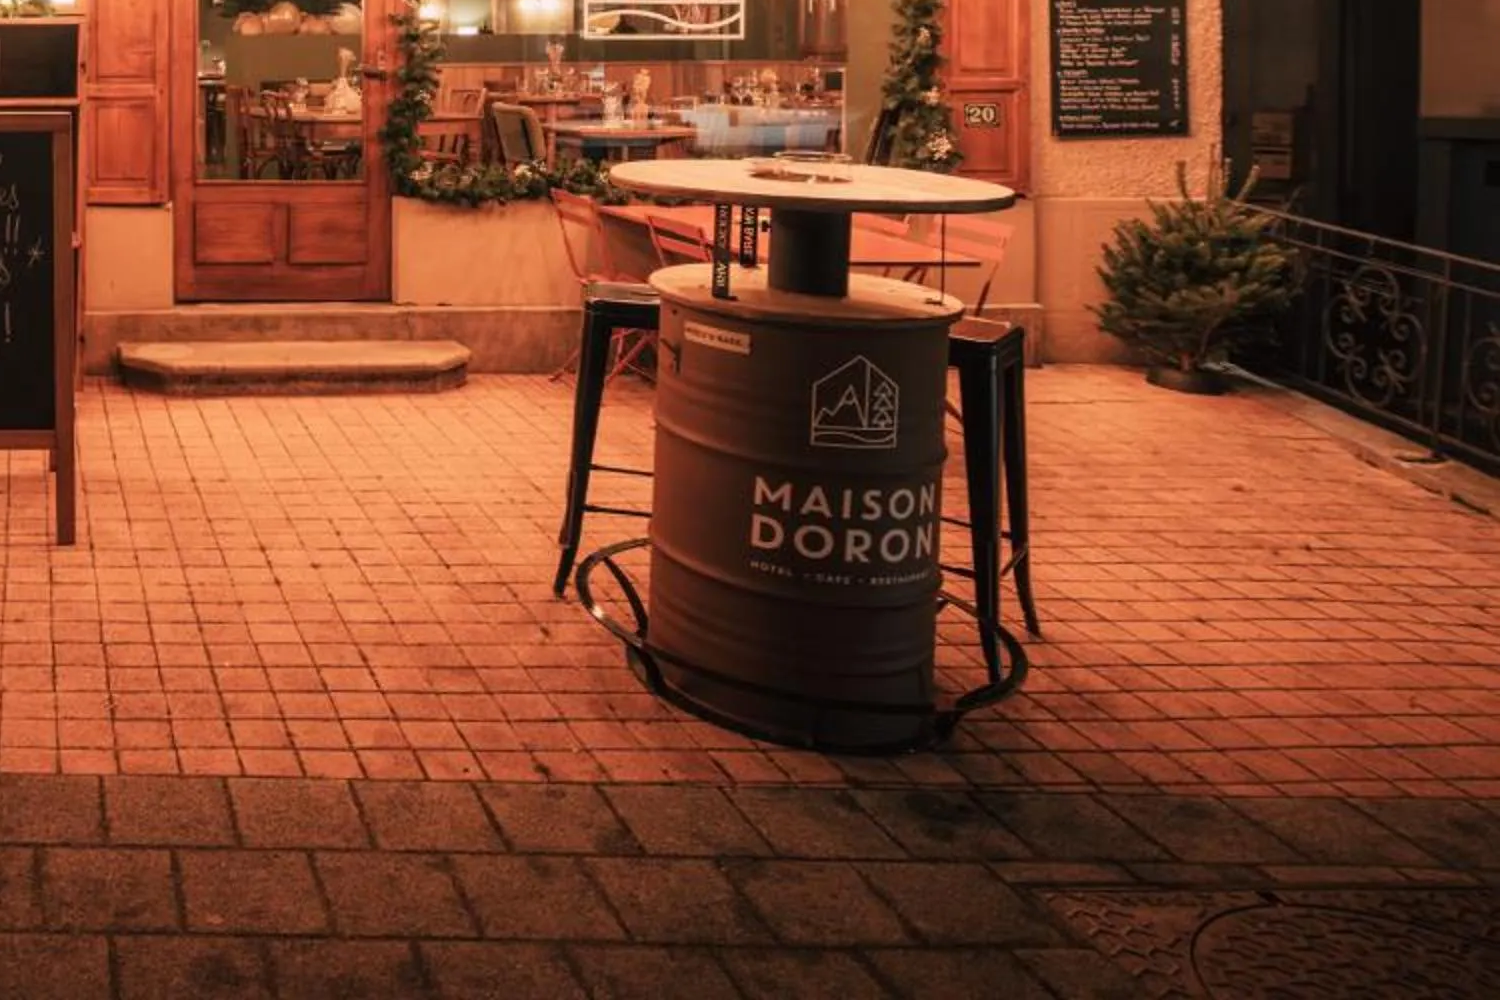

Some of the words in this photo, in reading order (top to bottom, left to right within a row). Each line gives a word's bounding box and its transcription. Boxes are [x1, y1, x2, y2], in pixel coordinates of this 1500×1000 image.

[968, 106, 995, 123] 20
[753, 475, 936, 521] MAISON
[751, 512, 934, 563] DORON
